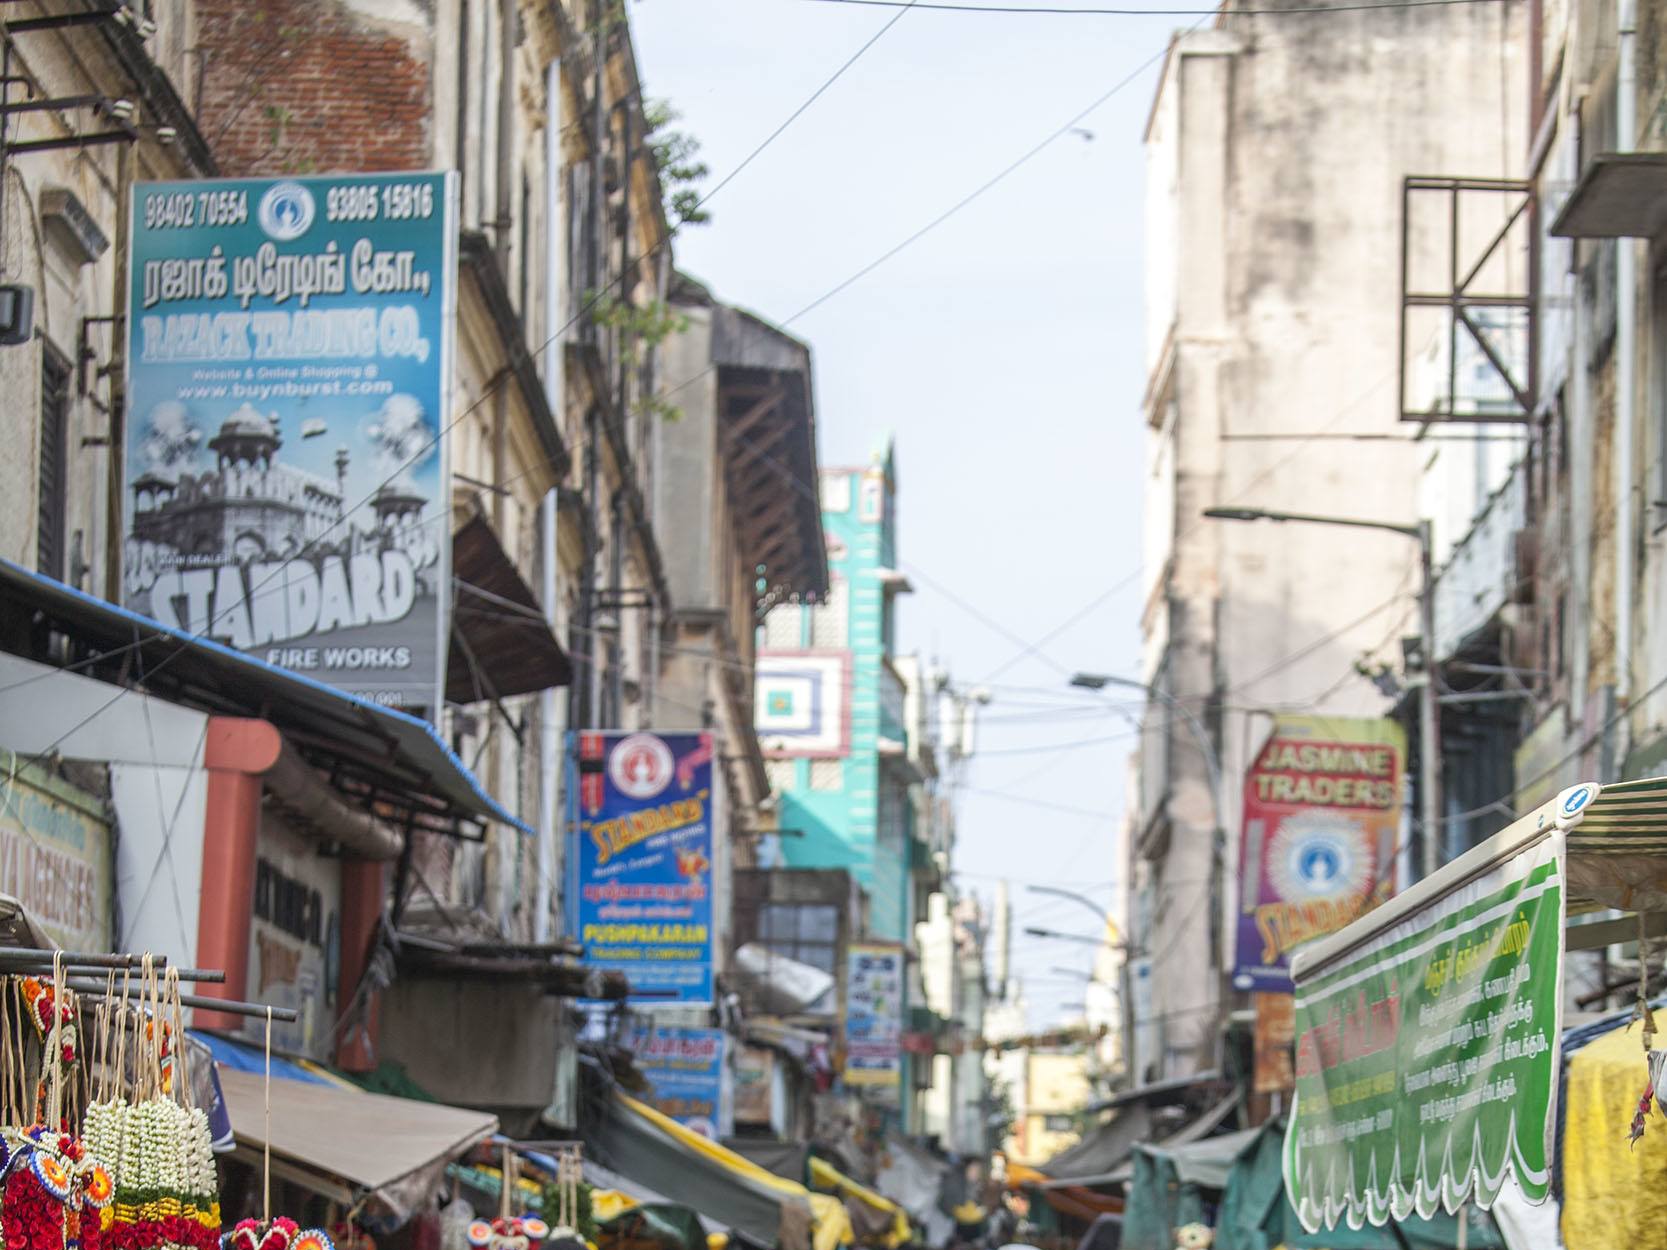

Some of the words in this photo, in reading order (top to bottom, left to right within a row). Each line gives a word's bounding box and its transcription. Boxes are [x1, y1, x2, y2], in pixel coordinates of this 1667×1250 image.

[144, 191, 194, 230] 98402
[198, 189, 248, 226] 70554
[142, 246, 228, 309] ரஜாக்
[233, 240, 346, 308] டிரேடிங்
[140, 312, 250, 362] RAZACK
[251, 307, 377, 359] TRADING
[176, 378, 394, 400] www.buynburst.com
[193, 367, 241, 380] Website
[246, 367, 255, 379] &
[259, 366, 298, 378] Online
[301, 364, 361, 380] Shopping
[151, 549, 416, 650] STANDARD
[266, 649, 318, 669] FIRE
[324, 647, 411, 669] WORKS
[1262, 744, 1393, 776] JASMINE
[1256, 774, 1394, 808] TRADERS
[591, 797, 704, 865] STANDARD
